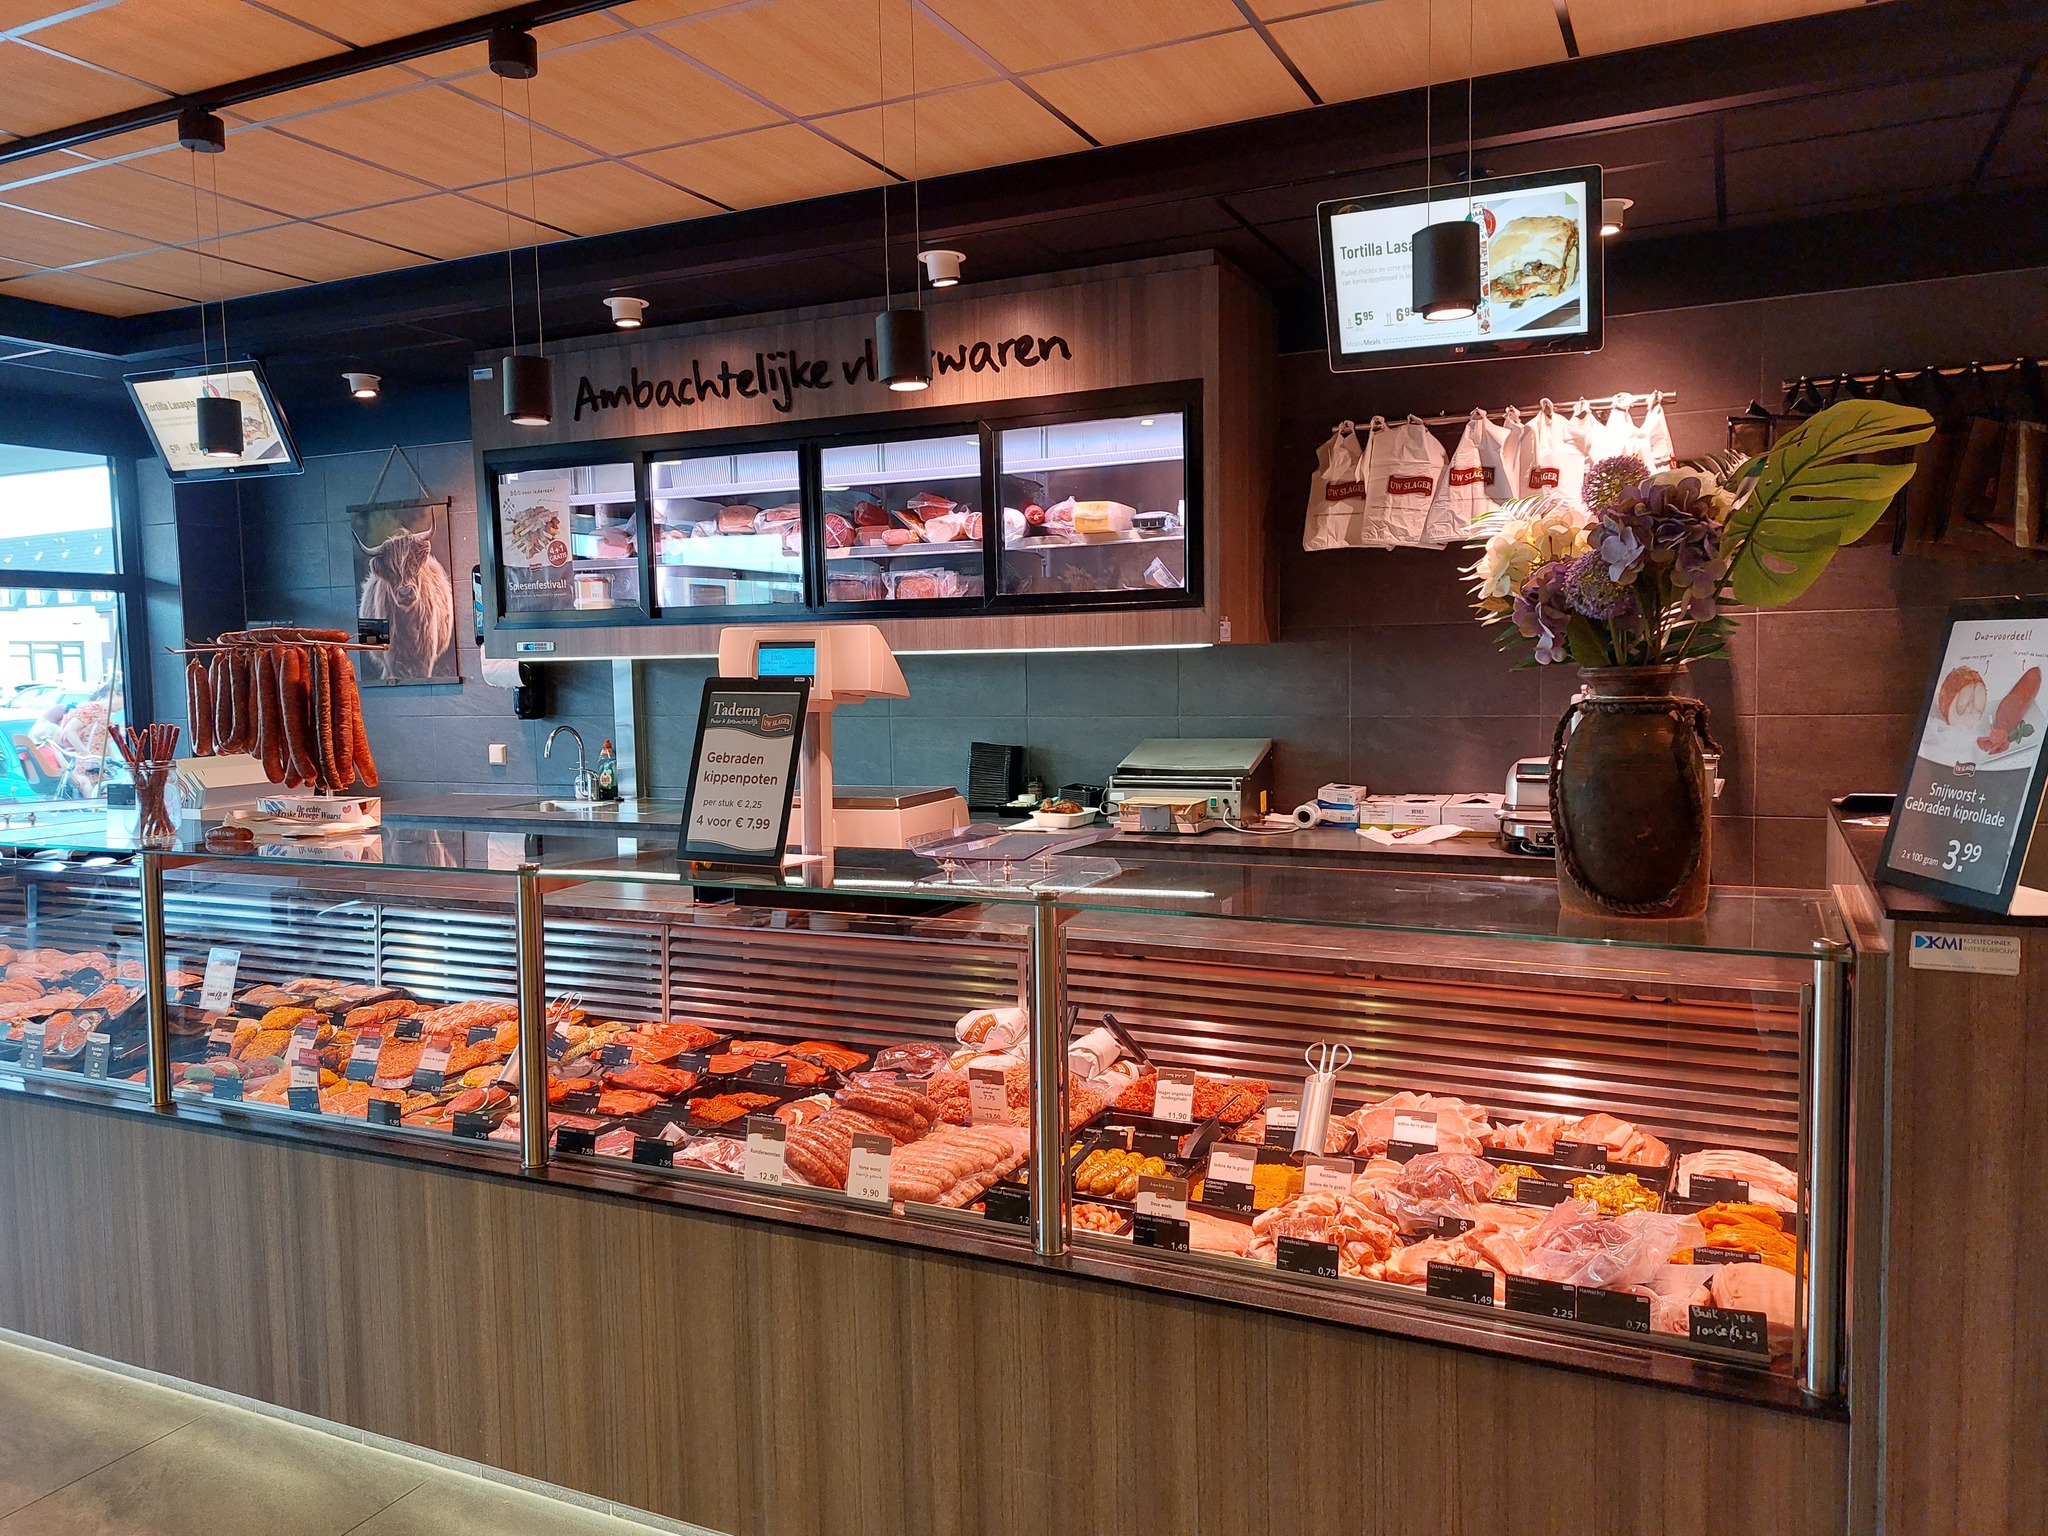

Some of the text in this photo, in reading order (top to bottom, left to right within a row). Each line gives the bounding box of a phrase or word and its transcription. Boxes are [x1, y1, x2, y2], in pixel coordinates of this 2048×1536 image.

[1340, 240, 1413, 260] Tortilla Lasa
[573, 333, 1073, 423] Ambachtelijke vlwaren
[145, 399, 197, 413] Tortilla Lasagna
[1451, 473, 1464, 483] UW
[1390, 480, 1431, 491] UW SLAGER
[1327, 488, 1339, 497] UW
[549, 543, 564, 554] 4+1
[549, 552, 568, 562] GRATIS
[508, 579, 567, 592] Spiesenfestival!
[1974, 629, 2033, 641] Duo-voordeel!
[712, 701, 761, 717] Tadema
[763, 717, 790, 727] UW SLAGER
[707, 751, 764, 764] Gebraden
[703, 770, 778, 786] kippenpoten
[1929, 782, 1986, 804] Snijworst +
[306, 804, 321, 813] echte
[703, 799, 763, 809] per stuk € 2,25
[298, 811, 319, 820] Droege
[321, 811, 341, 820] Woarst
[1904, 796, 2006, 827] Gebraden kiprollade
[696, 815, 771, 830] 4 voor € 7,99
[1901, 850, 1907, 858] 2
[1912, 852, 1923, 862] 100
[1923, 856, 1939, 866] gram
[1927, 936, 1963, 951] KMI
[1963, 937, 2012, 947] KOELTECHNIEK
[1555, 1141, 1578, 1149] Hamlappen
[1691, 1174, 1717, 1183] Speklappen
[1149, 1182, 1175, 1191] Aanbieding
[1279, 1237, 1310, 1247] Vleeskrabben
[1317, 1266, 1337, 1277] 0,79
[1507, 1275, 1540, 1286] Varkenshaas
[1578, 1287, 1607, 1298] Hamschijf
[1472, 1293, 1492, 1305] 1,49
